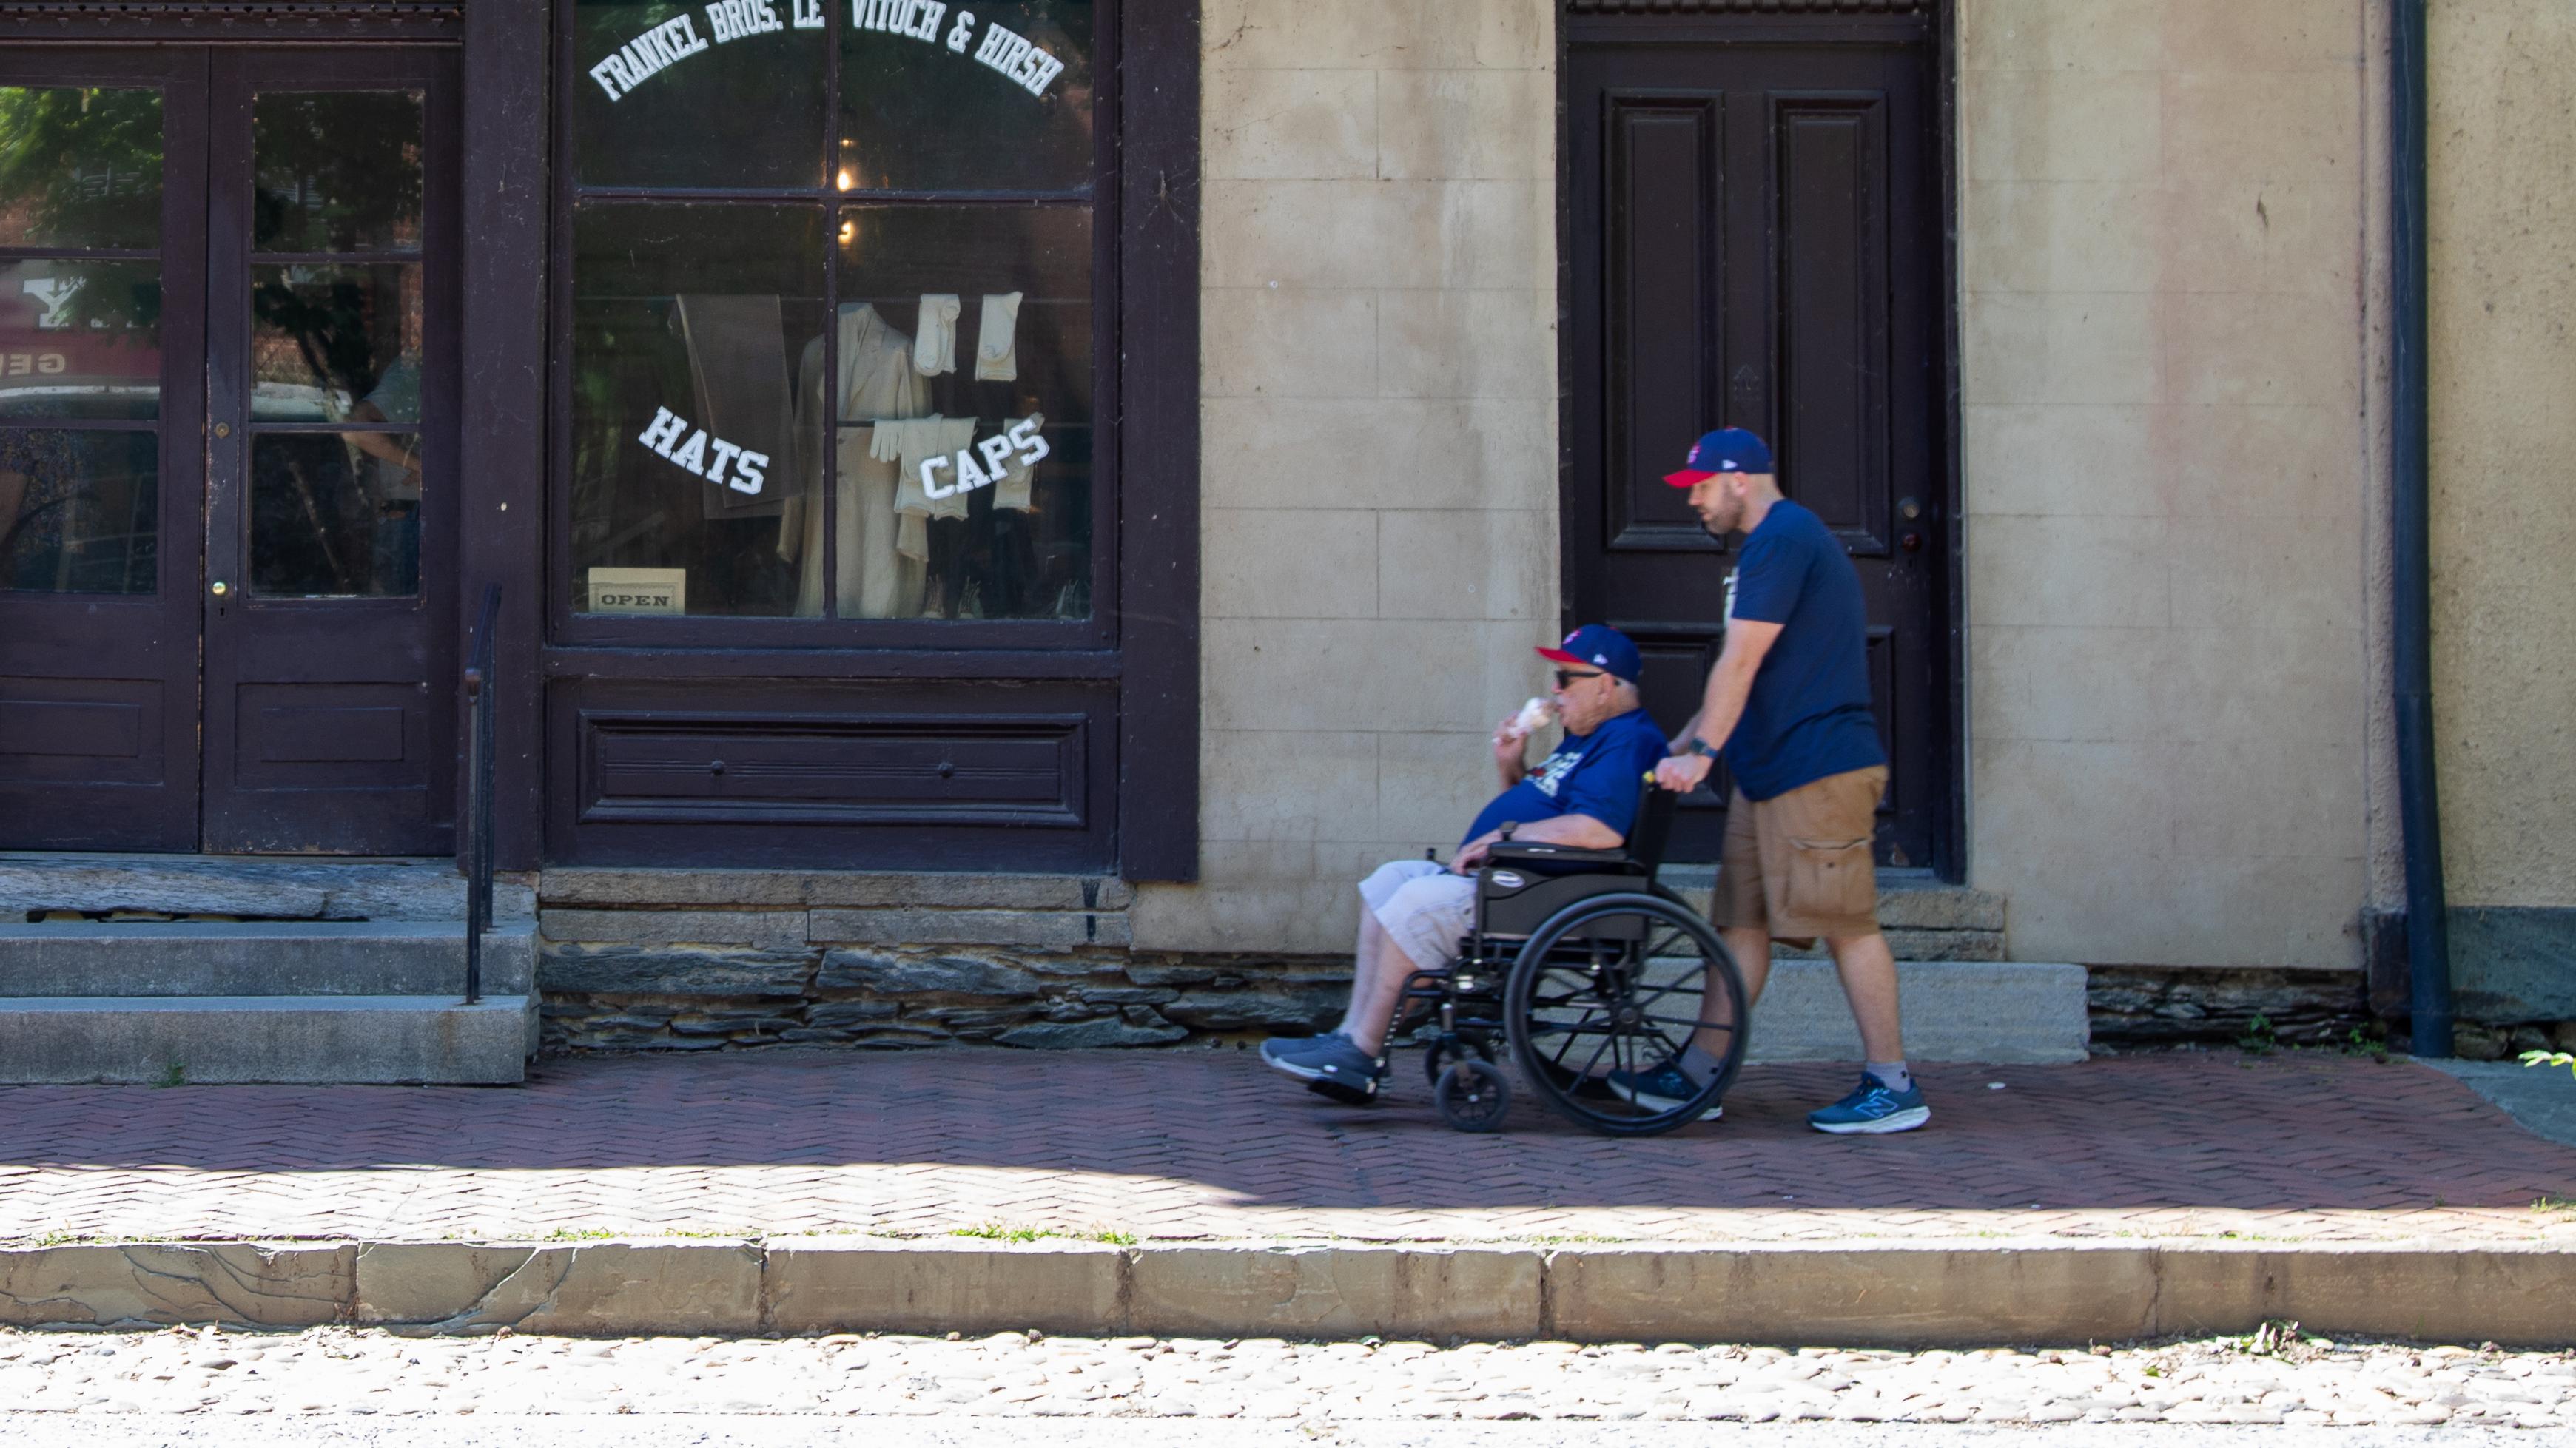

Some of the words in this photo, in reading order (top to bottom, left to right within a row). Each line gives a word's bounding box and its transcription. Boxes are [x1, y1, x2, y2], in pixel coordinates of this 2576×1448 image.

[589, 13, 709, 101] FRANKEL
[704, 0, 784, 43] BROS.
[946, 10, 975, 53] &
[975, 22, 1064, 97] HIRSH
[639, 405, 769, 495] HATS
[920, 418, 1050, 500] CAPS
[601, 594, 669, 606] OPEN
